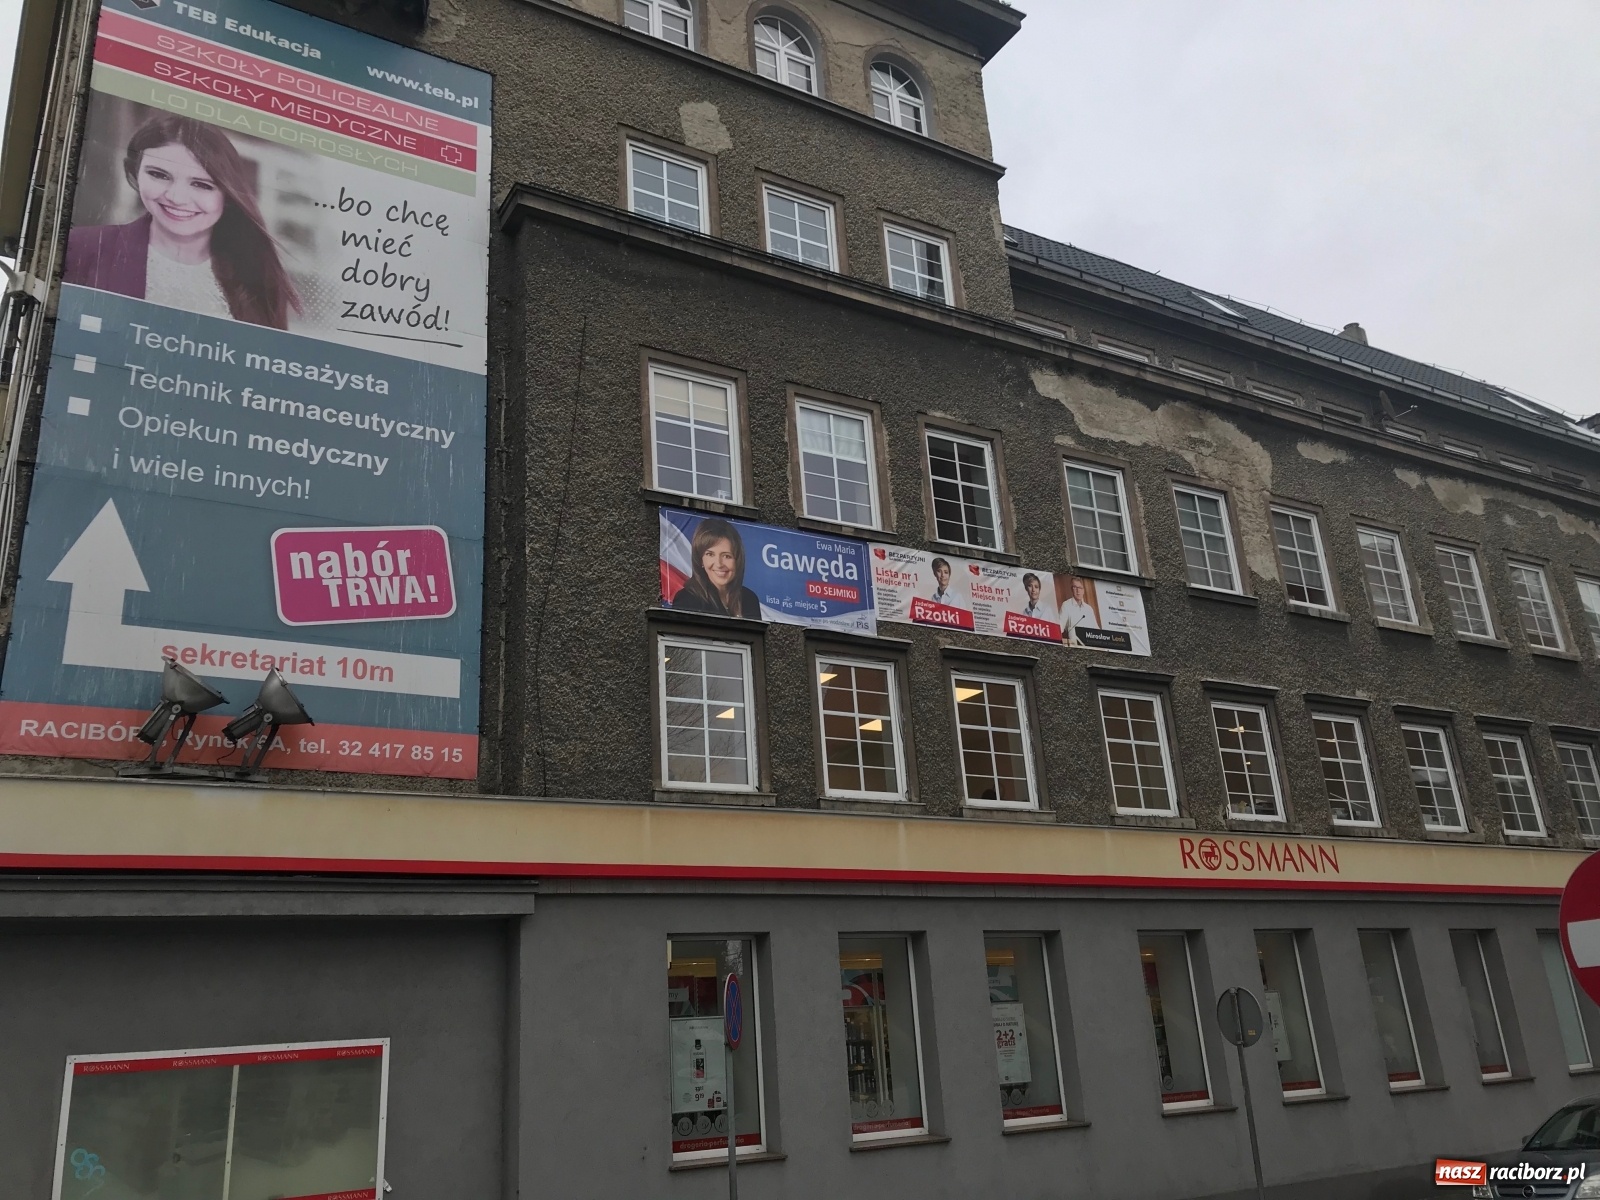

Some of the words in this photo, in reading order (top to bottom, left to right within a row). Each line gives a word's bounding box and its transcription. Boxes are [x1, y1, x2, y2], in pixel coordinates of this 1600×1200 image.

[173, 1, 217, 24] TEB
[224, 17, 322, 60] Edukacja
[156, 35, 271, 78] SZKOŁY
[277, 72, 439, 132] POLICEALNE
[366, 65, 479, 109] www.teb.pl
[154, 61, 264, 103] SZKOŁY
[271, 96, 417, 150] MEDYCZNE
[151, 89, 188, 109] LO
[195, 104, 251, 129] DLA
[258, 120, 418, 176] DOROSŁYCH
[314, 187, 372, 216] ...bo
[386, 200, 449, 236] chcę
[341, 228, 414, 257] mieć
[341, 258, 430, 302] dobry
[341, 300, 450, 331] zawód!
[129, 322, 236, 365] Technik
[245, 352, 389, 395] masażysta
[124, 362, 232, 405] Technik
[241, 387, 456, 449] farmaceutyczny
[118, 406, 238, 446] Opiekun
[247, 433, 389, 476] medyczny
[112, 447, 120, 469] i
[129, 454, 205, 482] wiele
[214, 464, 311, 500] innych!
[289, 541, 411, 580] nabór
[761, 543, 859, 582] Gawęda
[816, 541, 832, 551] Ewa
[834, 543, 856, 556] Maria
[875, 566, 899, 579] Lista
[902, 572, 911, 580] nr
[914, 573, 918, 581] 1
[876, 577, 902, 586] Miejsce
[322, 575, 439, 607] TRWA!
[766, 595, 780, 605] lista
[794, 600, 819, 611] miejsce
[820, 600, 828, 614] 5
[809, 584, 822, 594] DO
[823, 586, 857, 600] SEJMIKU
[914, 600, 936, 609] Jadwiga
[971, 582, 993, 594] Lista
[995, 587, 1004, 595] nr
[1006, 588, 1011, 597] 1
[971, 592, 996, 601] Miejsce
[856, 620, 870, 630] PiS
[915, 606, 960, 625] Rzotki
[1008, 620, 1051, 638] Rzotki
[162, 643, 326, 677] sekretariat
[336, 657, 394, 683] 10m
[20, 719, 167, 747] RACIBÓR,
[299, 738, 331, 755] tel.
[338, 740, 362, 756] 32
[368, 743, 405, 759] 417
[411, 745, 434, 761] 85
[441, 747, 463, 763] 15
[1179, 837, 1340, 874] ROSSMANN
[995, 1029, 1016, 1041] 2+2
[996, 1039, 1016, 1049] gratis
[172, 1057, 217, 1067] ROSSMANN
[257, 1052, 299, 1062] ROSSMANN
[336, 1047, 376, 1057] ROSSMANN
[83, 1063, 130, 1073] ROSSMANN
